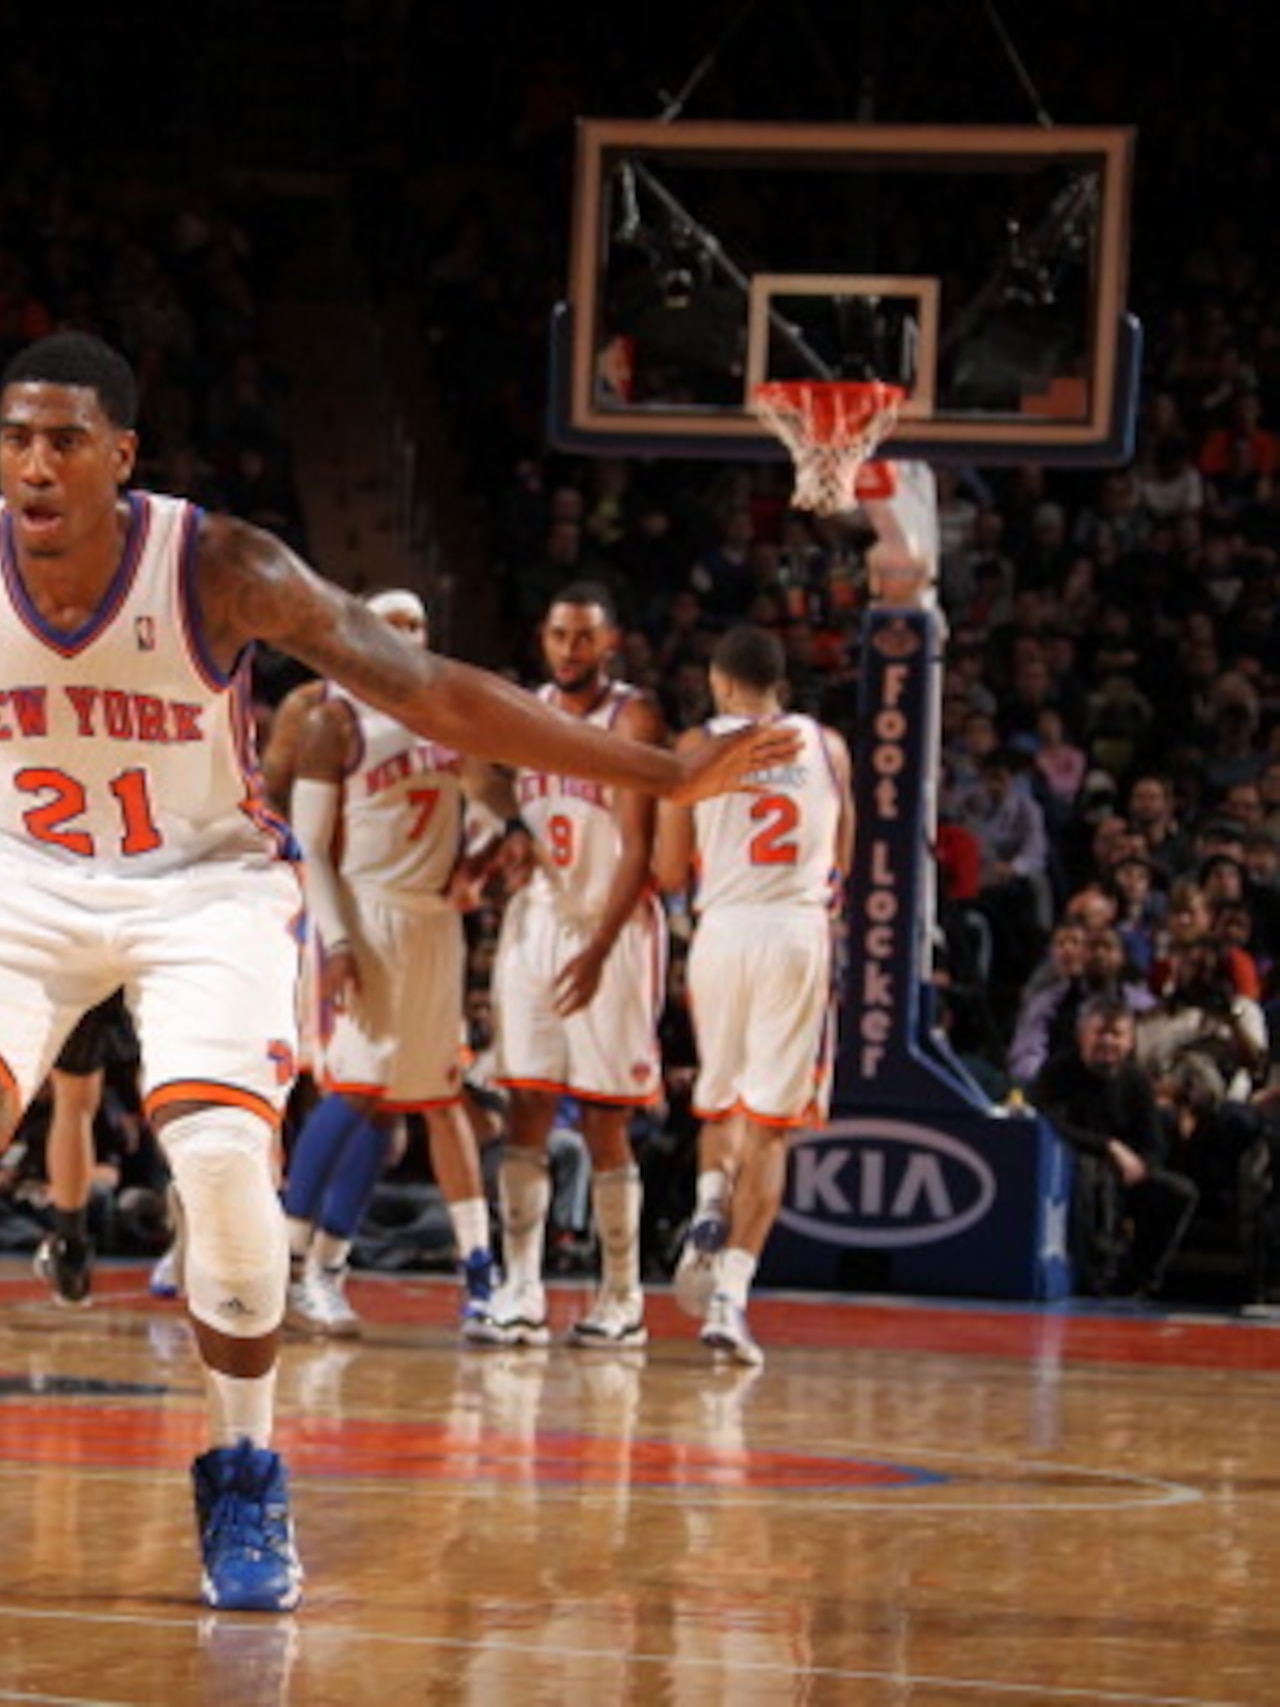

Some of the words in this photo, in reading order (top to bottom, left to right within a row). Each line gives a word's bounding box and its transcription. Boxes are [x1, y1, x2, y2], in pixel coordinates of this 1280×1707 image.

[62, 685, 205, 744] YORK
[13, 766, 162, 857] 21
[405, 788, 442, 842] 7
[546, 814, 576, 868] 9
[749, 795, 800, 867] 2
[793, 1145, 956, 1220] KIA
